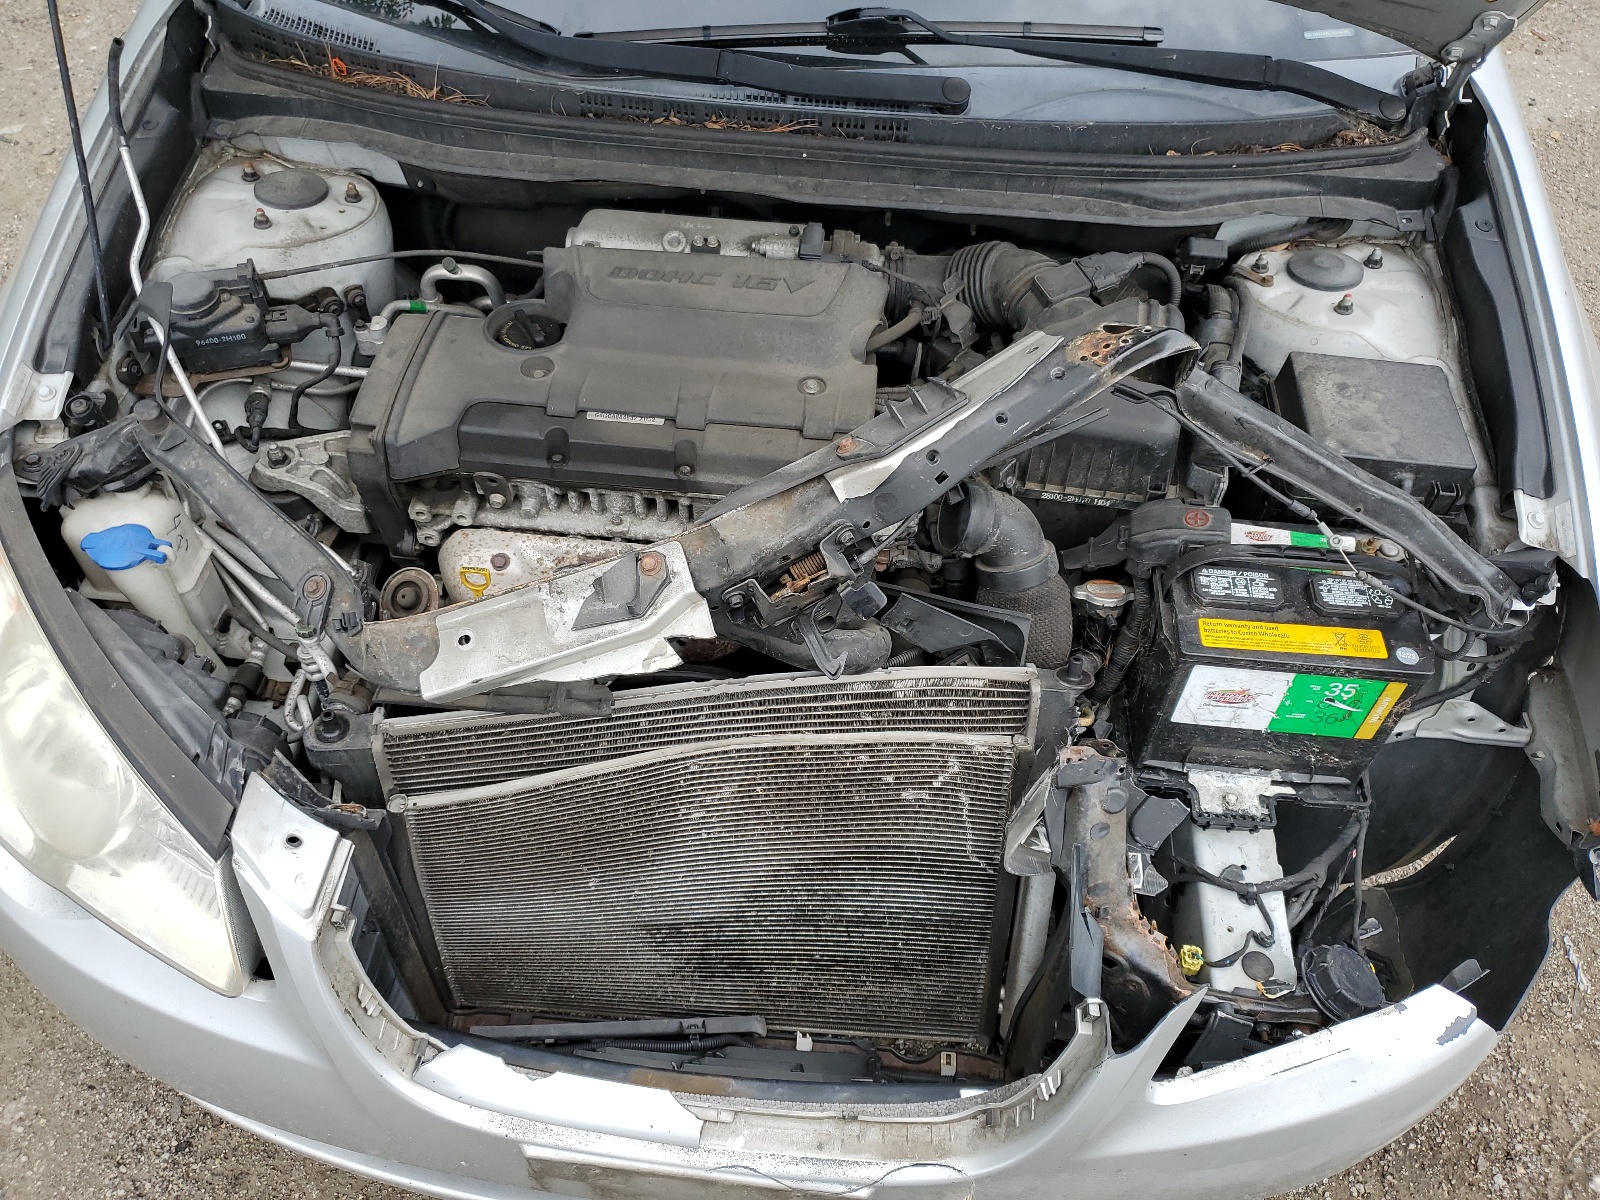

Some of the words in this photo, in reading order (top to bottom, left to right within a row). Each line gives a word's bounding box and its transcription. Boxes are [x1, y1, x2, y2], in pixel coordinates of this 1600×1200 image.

[195, 333, 247, 346] 96400-2H100
[1223, 622, 1251, 630] warranty
[1203, 627, 1231, 635] batteries
[1258, 630, 1290, 639] Wholesale
[1398, 651, 1416, 660] 12/23
[1324, 682, 1359, 698] 35
